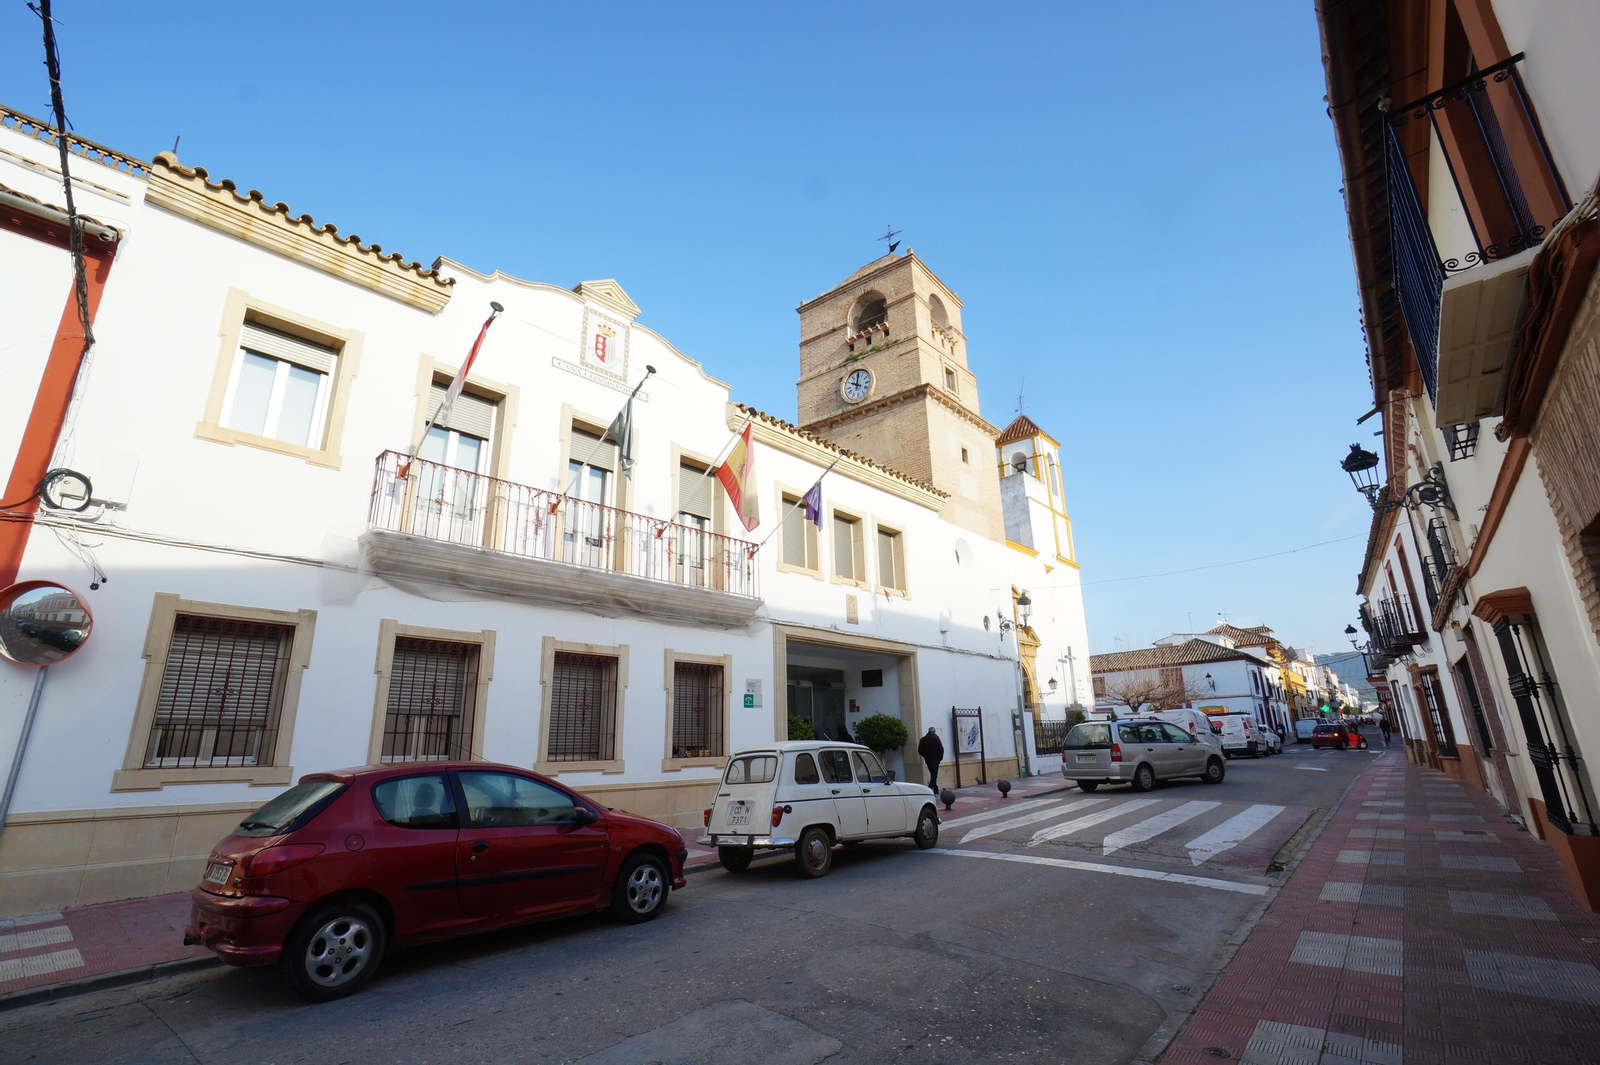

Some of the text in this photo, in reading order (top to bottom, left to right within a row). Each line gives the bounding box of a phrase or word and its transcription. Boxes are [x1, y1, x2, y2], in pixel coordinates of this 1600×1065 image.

[557, 361, 581, 375] CASA
[734, 806, 751, 815] CO N
[731, 815, 747, 824] 7371
